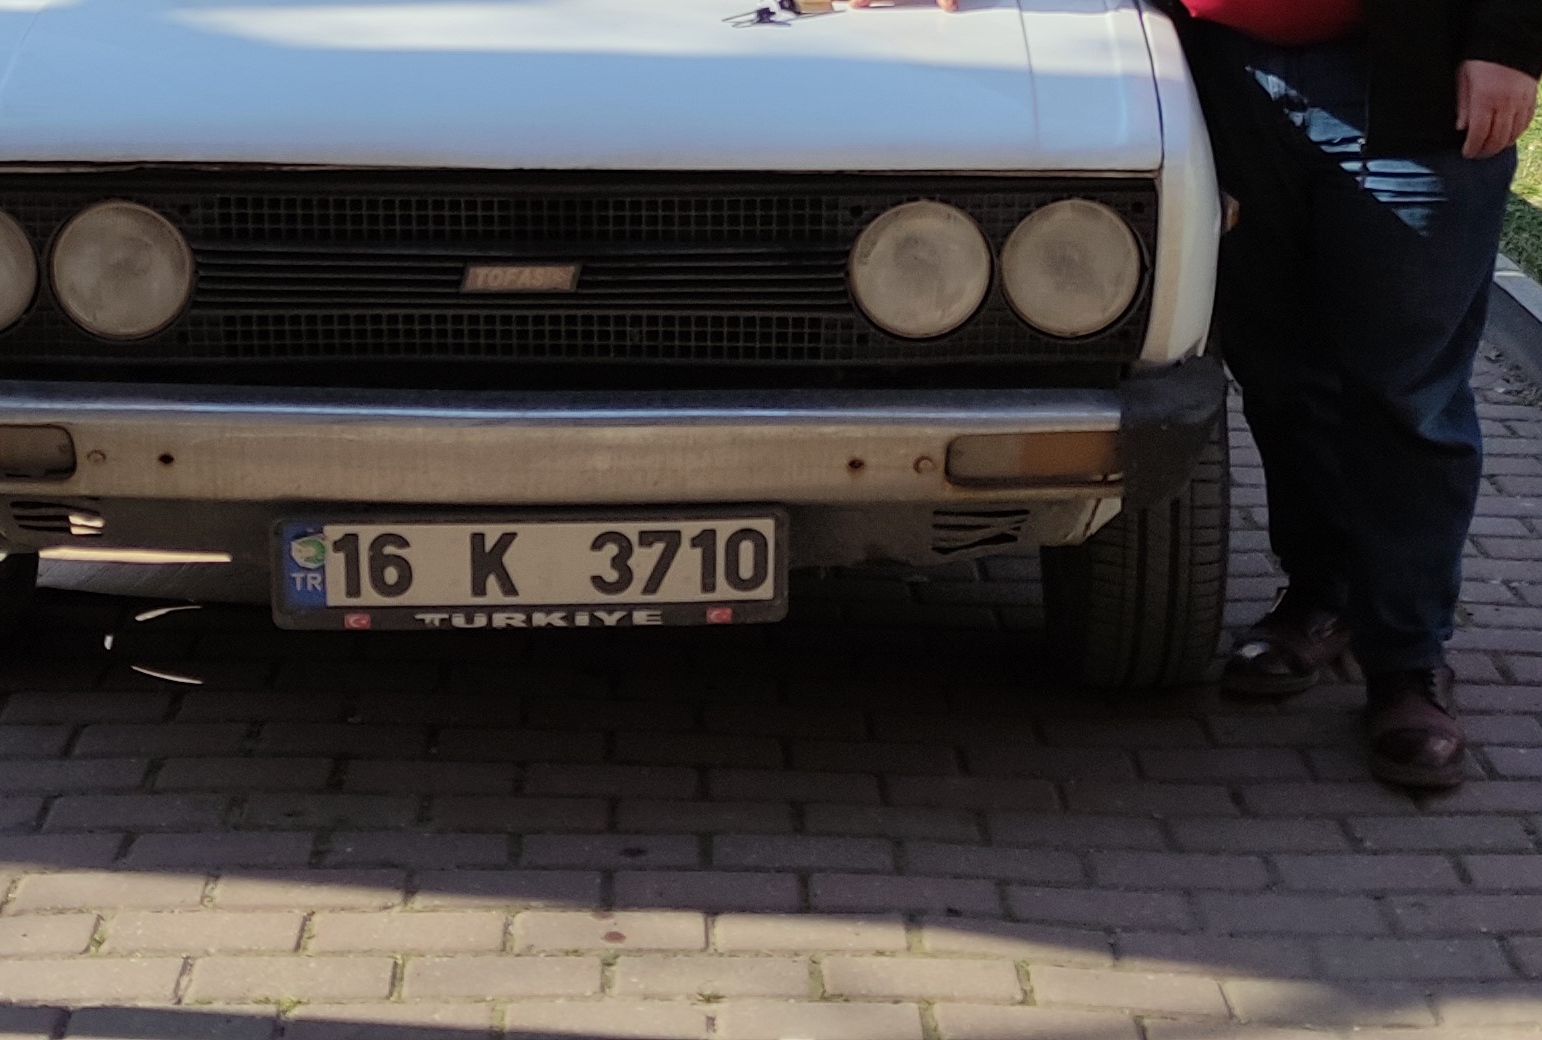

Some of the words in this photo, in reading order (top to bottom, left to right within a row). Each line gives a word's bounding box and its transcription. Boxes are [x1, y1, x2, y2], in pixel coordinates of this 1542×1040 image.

[291, 572, 322, 591] TR
[332, 532, 413, 599] 16
[470, 531, 520, 598] K
[590, 527, 769, 596] 3710
